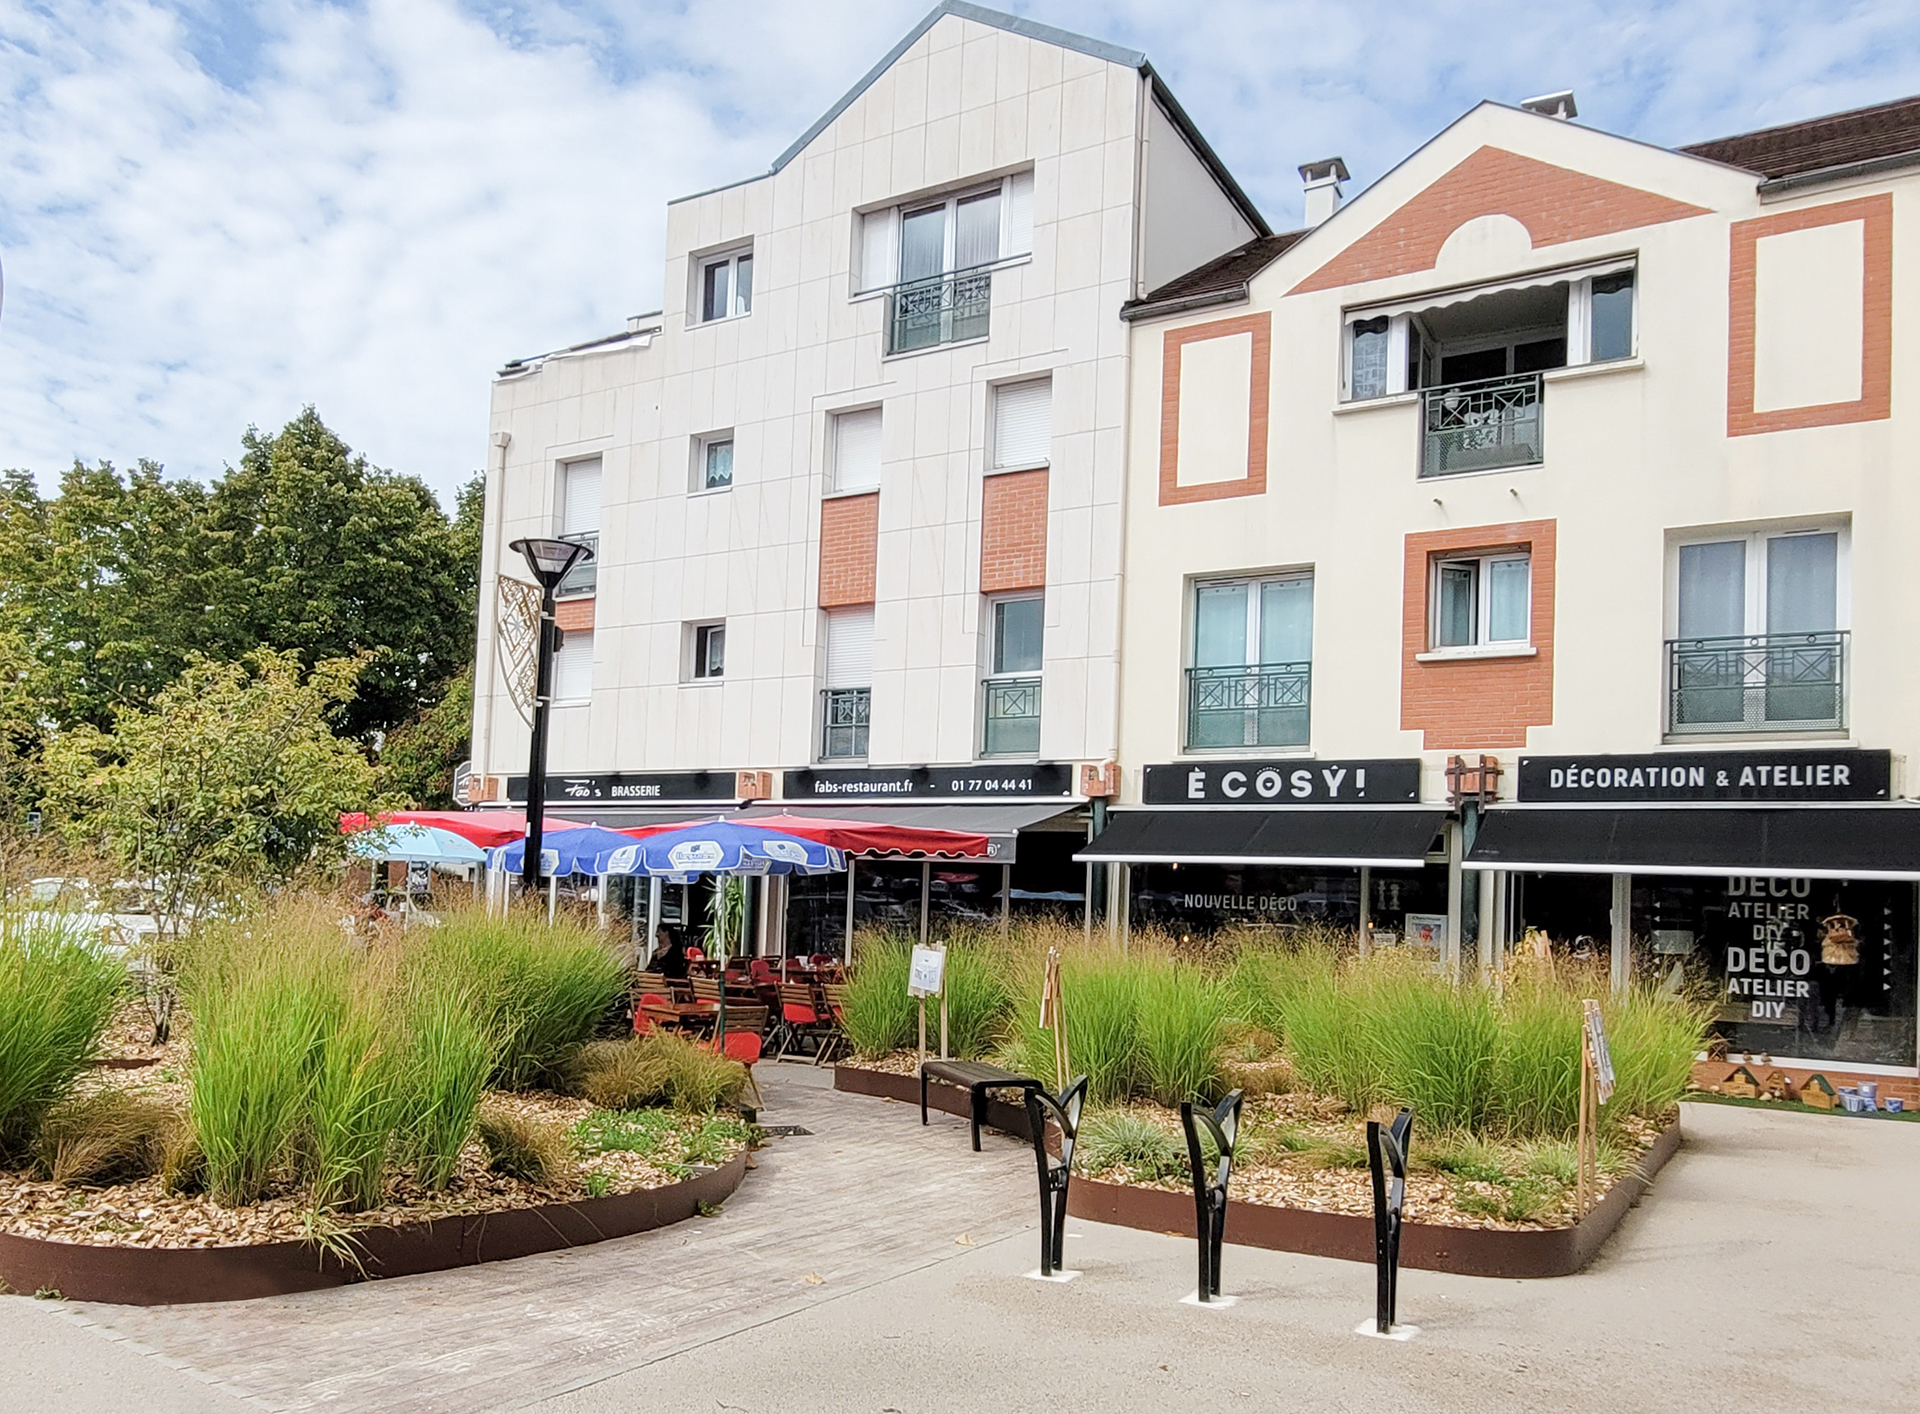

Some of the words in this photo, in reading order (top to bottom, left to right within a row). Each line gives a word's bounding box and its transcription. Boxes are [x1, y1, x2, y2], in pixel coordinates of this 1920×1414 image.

[1550, 764, 1705, 788] DÉCORATION
[1715, 770, 1729, 786] &
[1739, 764, 1850, 786] ATELIER
[611, 785, 661, 797] BRASSERIE
[814, 780, 914, 793] fabs-restaurant.fr
[951, 780, 965, 791] 01
[968, 780, 982, 790] 77
[984, 780, 999, 791] 04
[1001, 779, 1016, 790] 44
[1018, 779, 1033, 790] 41
[1184, 894, 1255, 910] NOUVELLE
[1259, 892, 1298, 912] DÉCO
[1727, 902, 1810, 920] ATELIER
[1753, 924, 1784, 940] DIY
[1727, 977, 1810, 998] ATELIER
[1752, 1001, 1786, 1019] DIY
